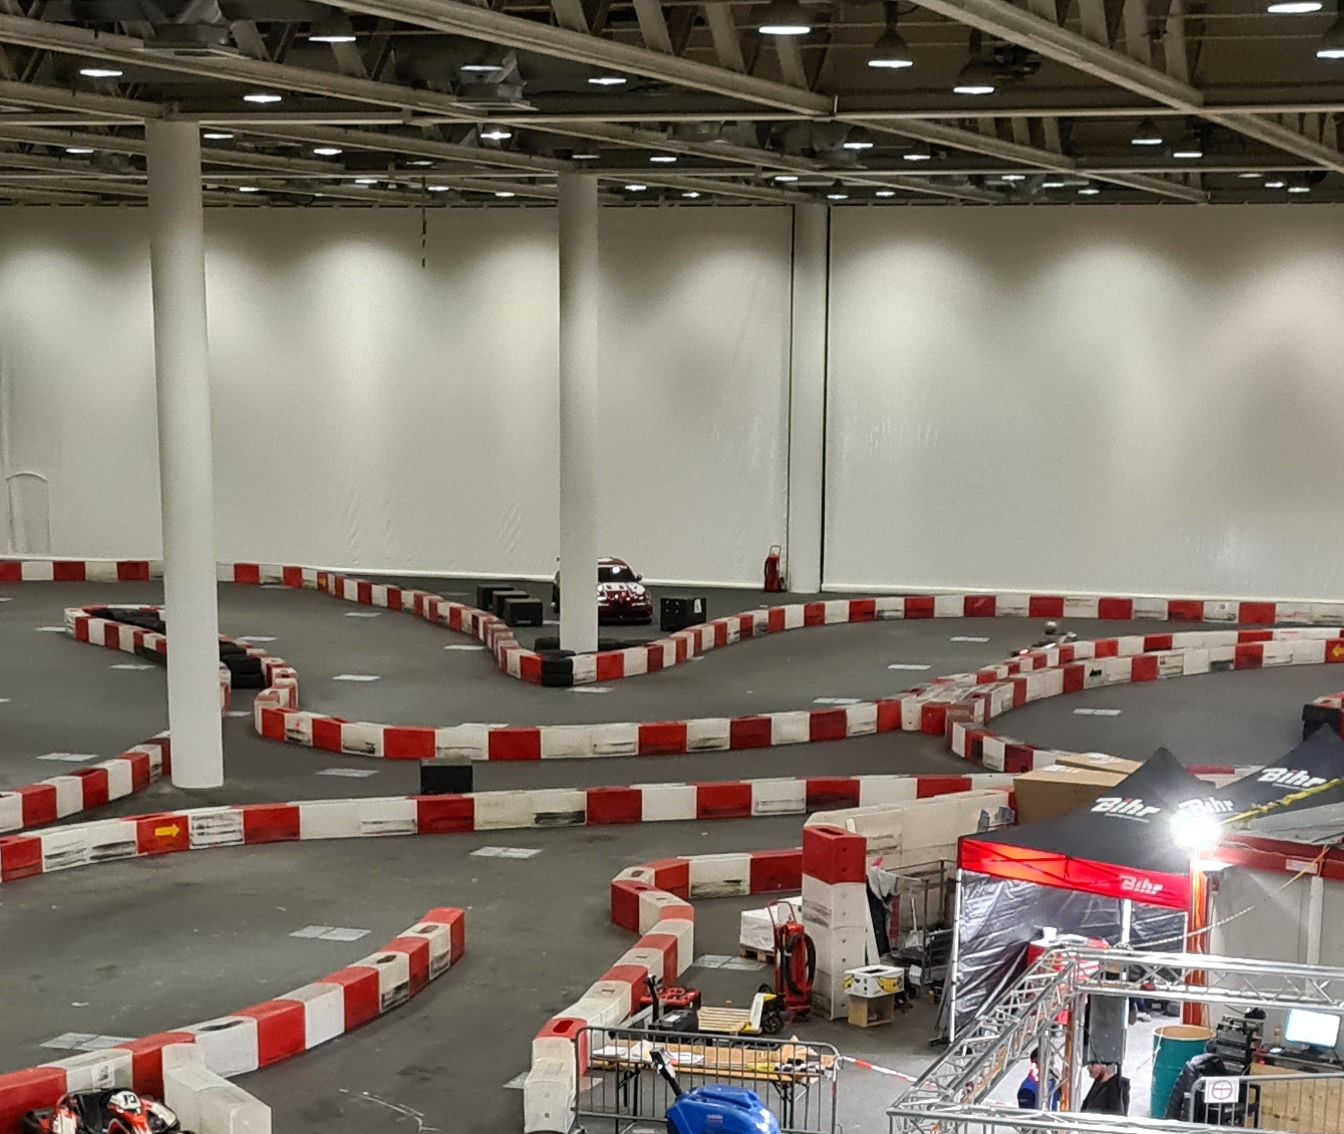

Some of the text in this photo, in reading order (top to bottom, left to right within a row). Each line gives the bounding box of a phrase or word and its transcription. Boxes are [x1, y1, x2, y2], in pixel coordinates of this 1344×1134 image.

[1258, 767, 1327, 787] Bihr
[1091, 796, 1161, 817] Bihr
[1120, 874, 1164, 896] Bihr
